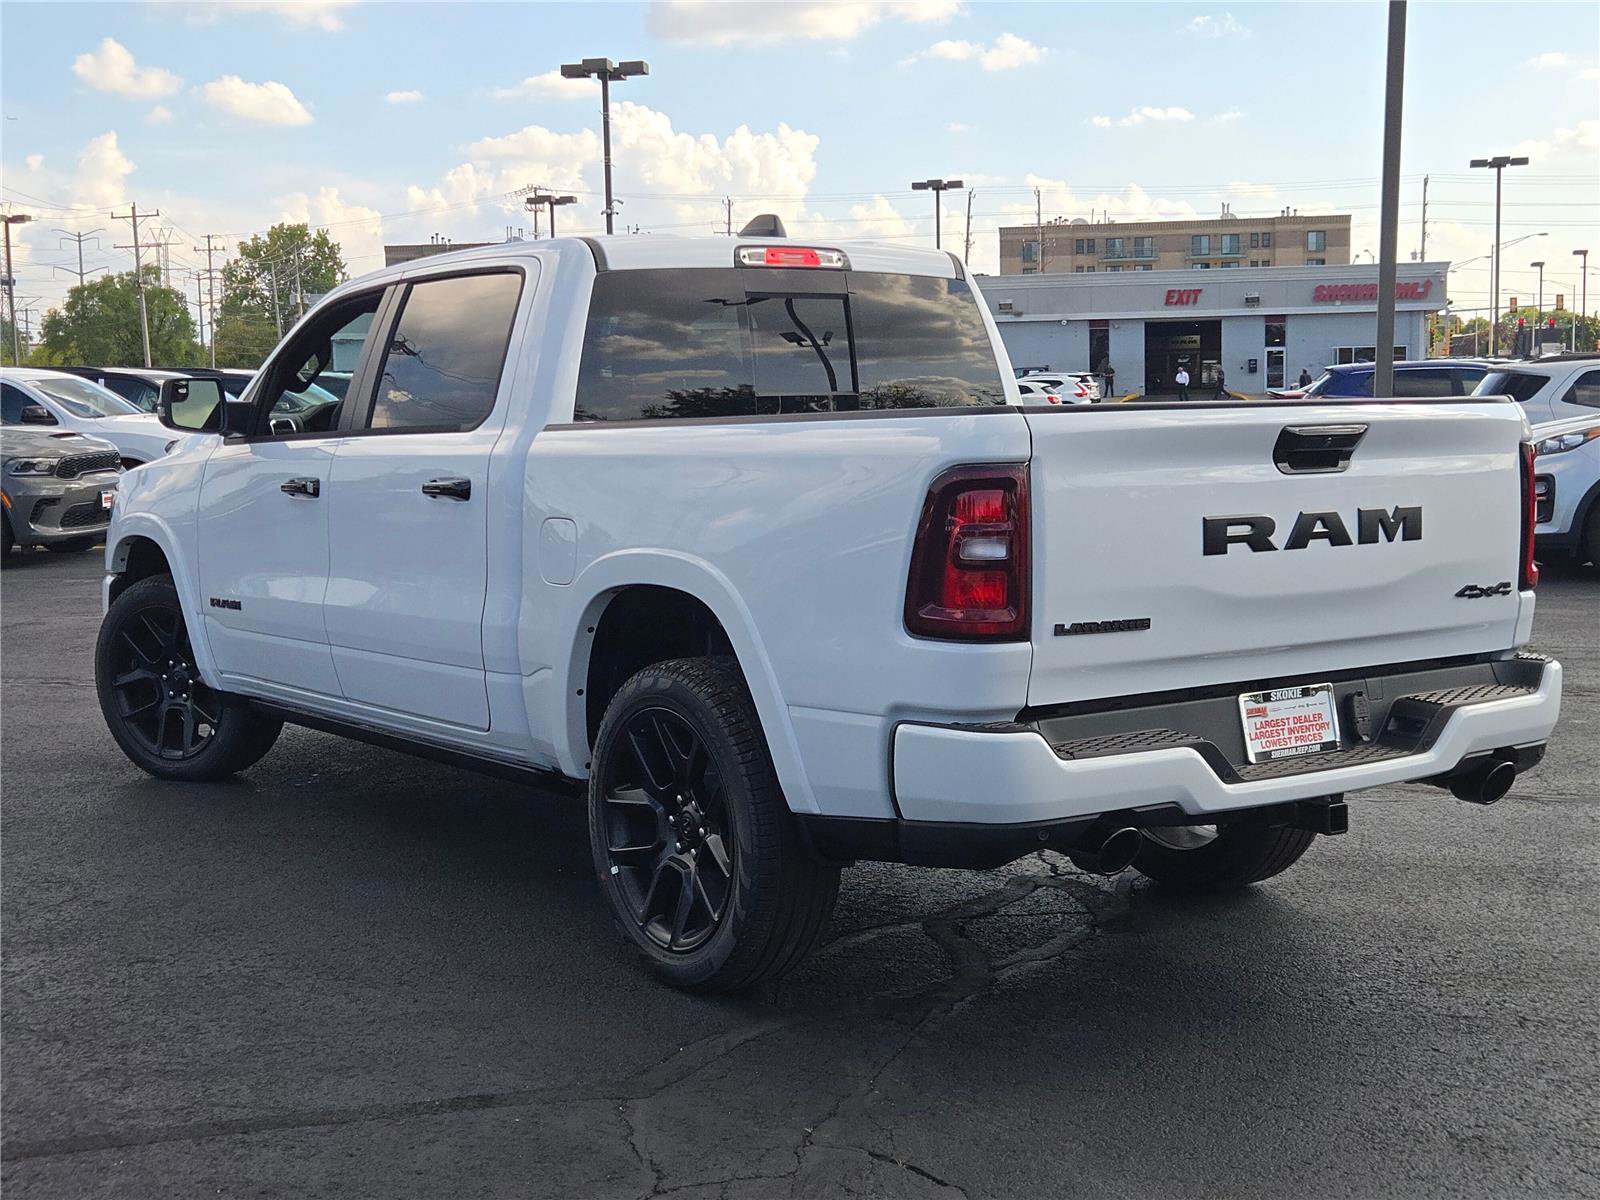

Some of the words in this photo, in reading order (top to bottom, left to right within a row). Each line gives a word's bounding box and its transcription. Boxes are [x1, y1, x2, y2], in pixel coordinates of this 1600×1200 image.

[1164, 288, 1203, 306] EXIT
[1313, 282, 1420, 303] SHOWRM
[1202, 505, 1422, 557] RAM
[1454, 581, 1512, 600] 4x4
[1270, 688, 1302, 701] SKOKIE
[1254, 717, 1290, 730] LARGEST
[1293, 713, 1323, 725] DEALER
[1249, 728, 1286, 741] LARGEST
[1287, 721, 1330, 735] INVENTORY
[1260, 738, 1293, 749] LOWEST
[1295, 732, 1323, 744] PRICES
